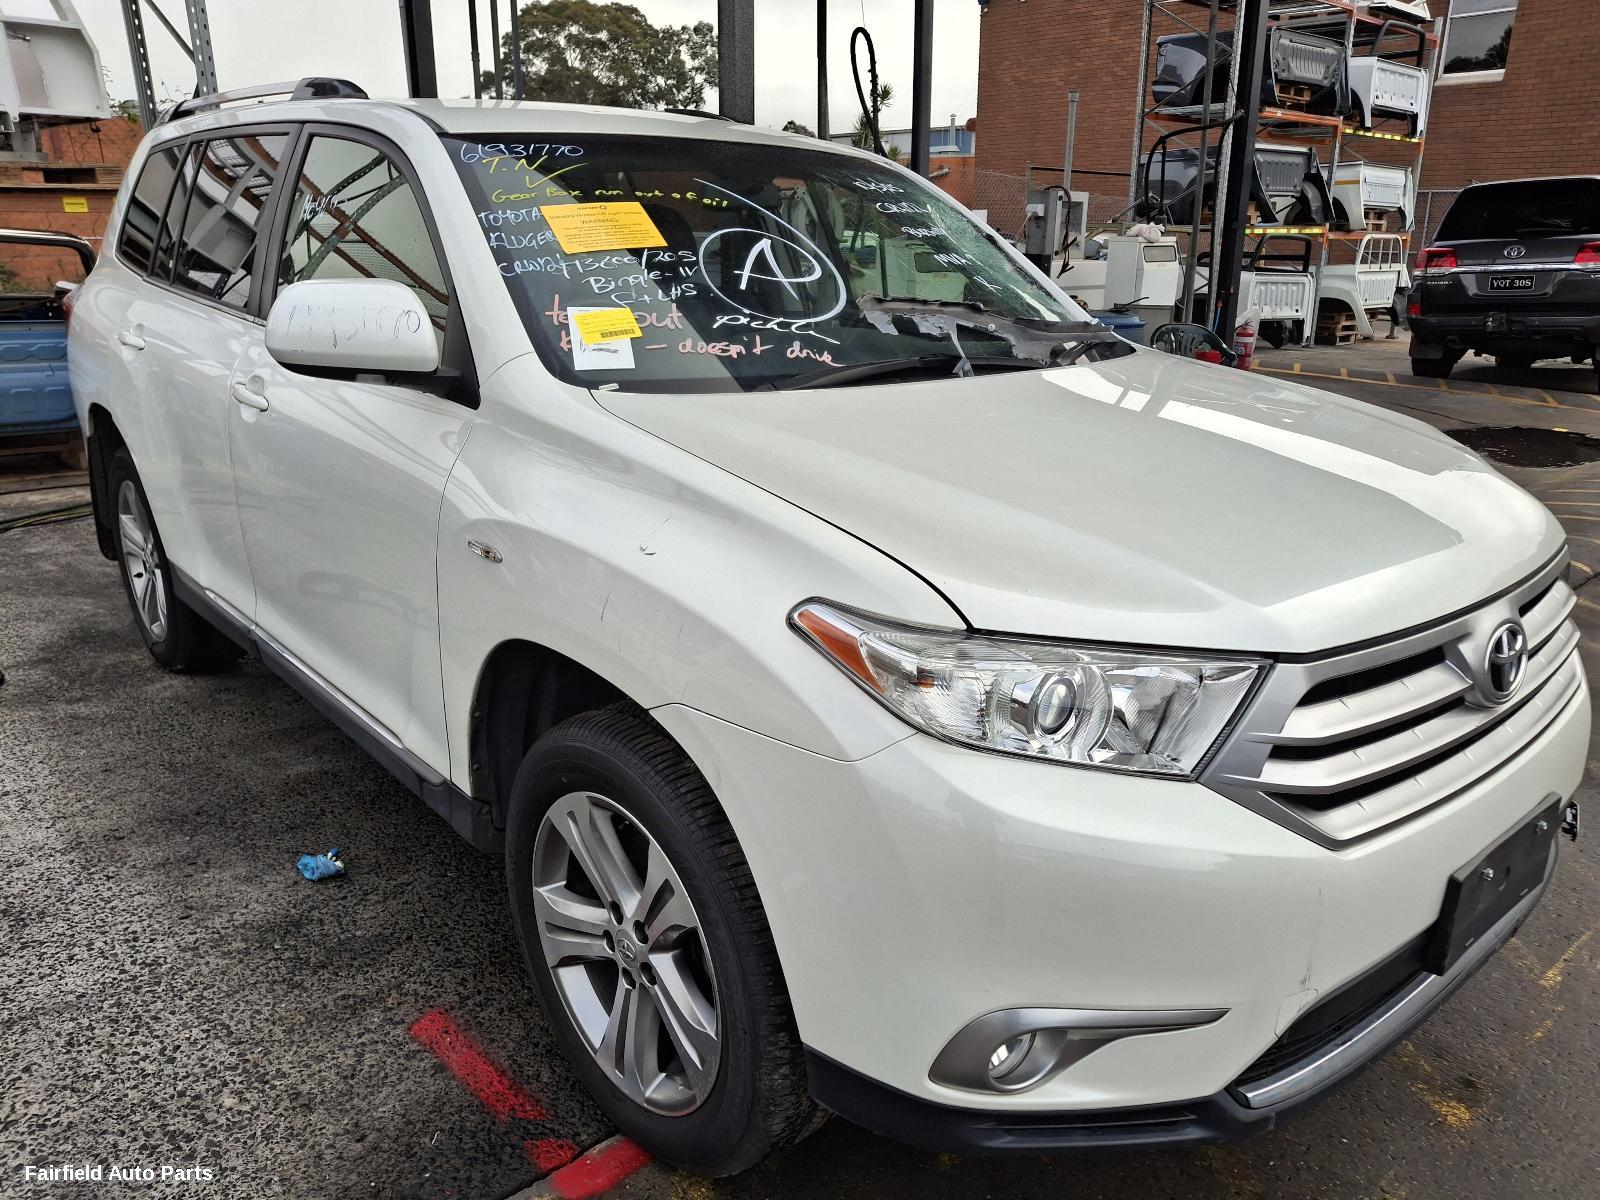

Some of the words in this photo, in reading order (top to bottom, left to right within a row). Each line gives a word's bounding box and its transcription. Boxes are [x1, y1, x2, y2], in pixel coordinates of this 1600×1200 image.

[491, 189, 537, 203] Gear
[545, 187, 584, 198] Box
[478, 206, 543, 228] TOYOTA
